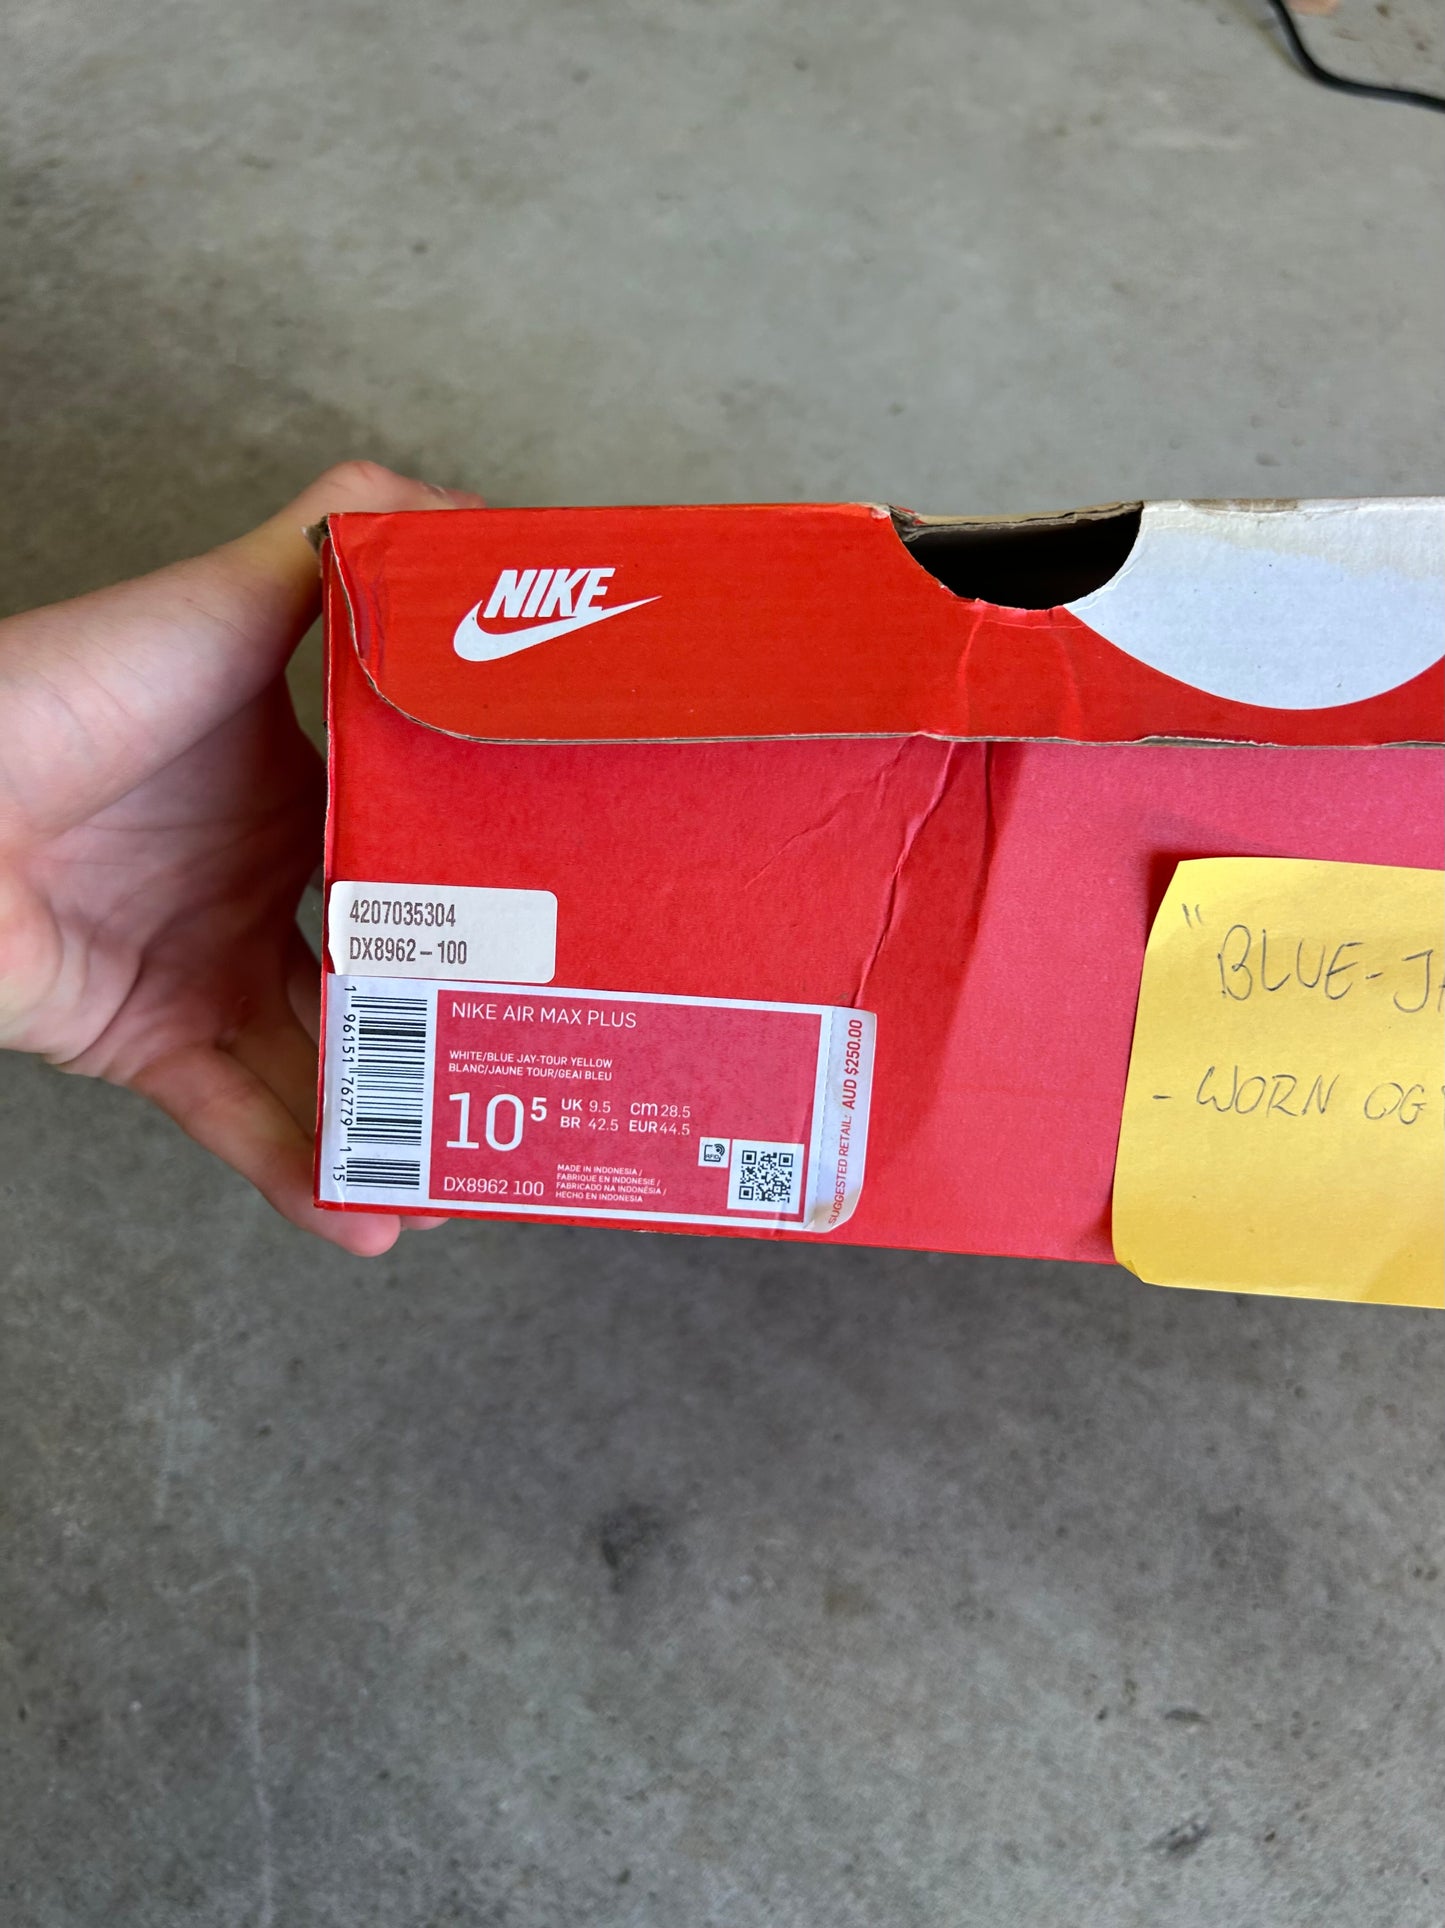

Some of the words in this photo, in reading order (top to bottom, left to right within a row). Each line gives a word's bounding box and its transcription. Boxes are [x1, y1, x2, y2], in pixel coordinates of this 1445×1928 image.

[483, 567, 616, 618] NIKE
[349, 899, 456, 927] 4207035304
[344, 985, 357, 993] 1
[452, 1002, 497, 1020] NIKE
[503, 1005, 534, 1022] AIR
[540, 1007, 582, 1025] MAX
[587, 1010, 637, 1028] PLUS
[341, 1013, 357, 1063] 96151
[846, 1020, 863, 1075] $250.00
[449, 1050, 514, 1063] WHITE/BLUE
[517, 1054, 567, 1065] JAY-TOUR
[570, 1057, 613, 1068] YELLOW
[448, 1063, 523, 1076] BLANC/JAUNE
[527, 1067, 582, 1079] TOUR/GEAI
[585, 1071, 612, 1081] BLEU
[340, 1076, 354, 1126] 76779
[842, 1079, 857, 1110] AUD
[1196, 1065, 1341, 1118] WORN
[1364, 1082, 1427, 1126] OG
[561, 1098, 583, 1111] UK
[589, 1100, 611, 1113] 9.5
[630, 1102, 658, 1116] cm
[660, 1104, 691, 1118] 28.5
[560, 1116, 581, 1129] BR
[588, 1118, 619, 1131] 42.5
[629, 1120, 658, 1133] EUR
[659, 1122, 690, 1136] 44.5
[839, 1115, 852, 1157] RETAIL:
[333, 1164, 345, 1181] 15
[557, 1164, 581, 1172] MADE
[583, 1165, 592, 1173] IN
[594, 1166, 638, 1175] INDONESIA
[598, 1175, 610, 1183] EN
[443, 1177, 508, 1194] DX8962
[514, 1180, 545, 1196] 100
[556, 1181, 602, 1191] FABRICADO
[603, 1184, 616, 1192] NA
[828, 1159, 848, 1225] SUGGESTED
[586, 1192, 597, 1200] EN
[599, 1193, 643, 1202] INDONESIA
